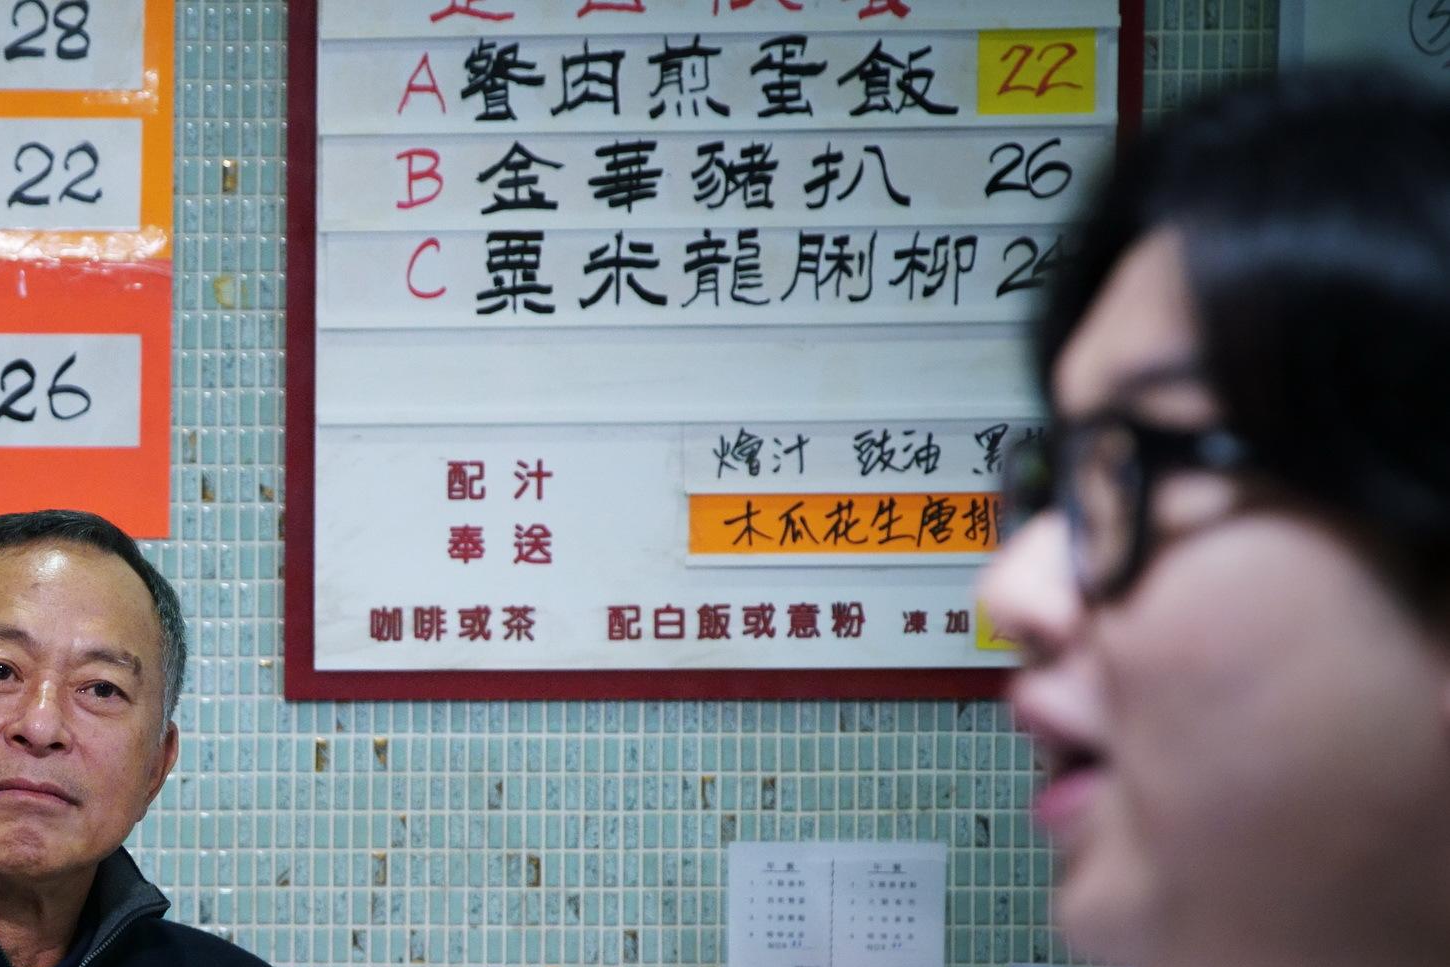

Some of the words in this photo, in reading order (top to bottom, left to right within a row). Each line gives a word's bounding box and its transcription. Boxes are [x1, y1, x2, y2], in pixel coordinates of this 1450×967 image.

[4, 0, 91, 61] 28
[398, 53, 446, 116] A
[460, 34, 959, 122] 餐肉煎蛋飯
[992, 34, 1084, 99] 22
[7, 141, 102, 207] 22
[396, 147, 444, 210] B
[477, 140, 911, 216] 金華豬扒
[984, 136, 1074, 201] 26
[406, 236, 448, 301] C
[476, 228, 978, 316] 粟米龍脷柳
[447, 458, 553, 501] 配汁
[853, 428, 941, 477] 豉油
[447, 523, 553, 565] 奉送
[369, 605, 536, 642] 咖啡或茶
[606, 601, 867, 641] 配白飯或意粉
[901, 609, 970, 635] 凍加
